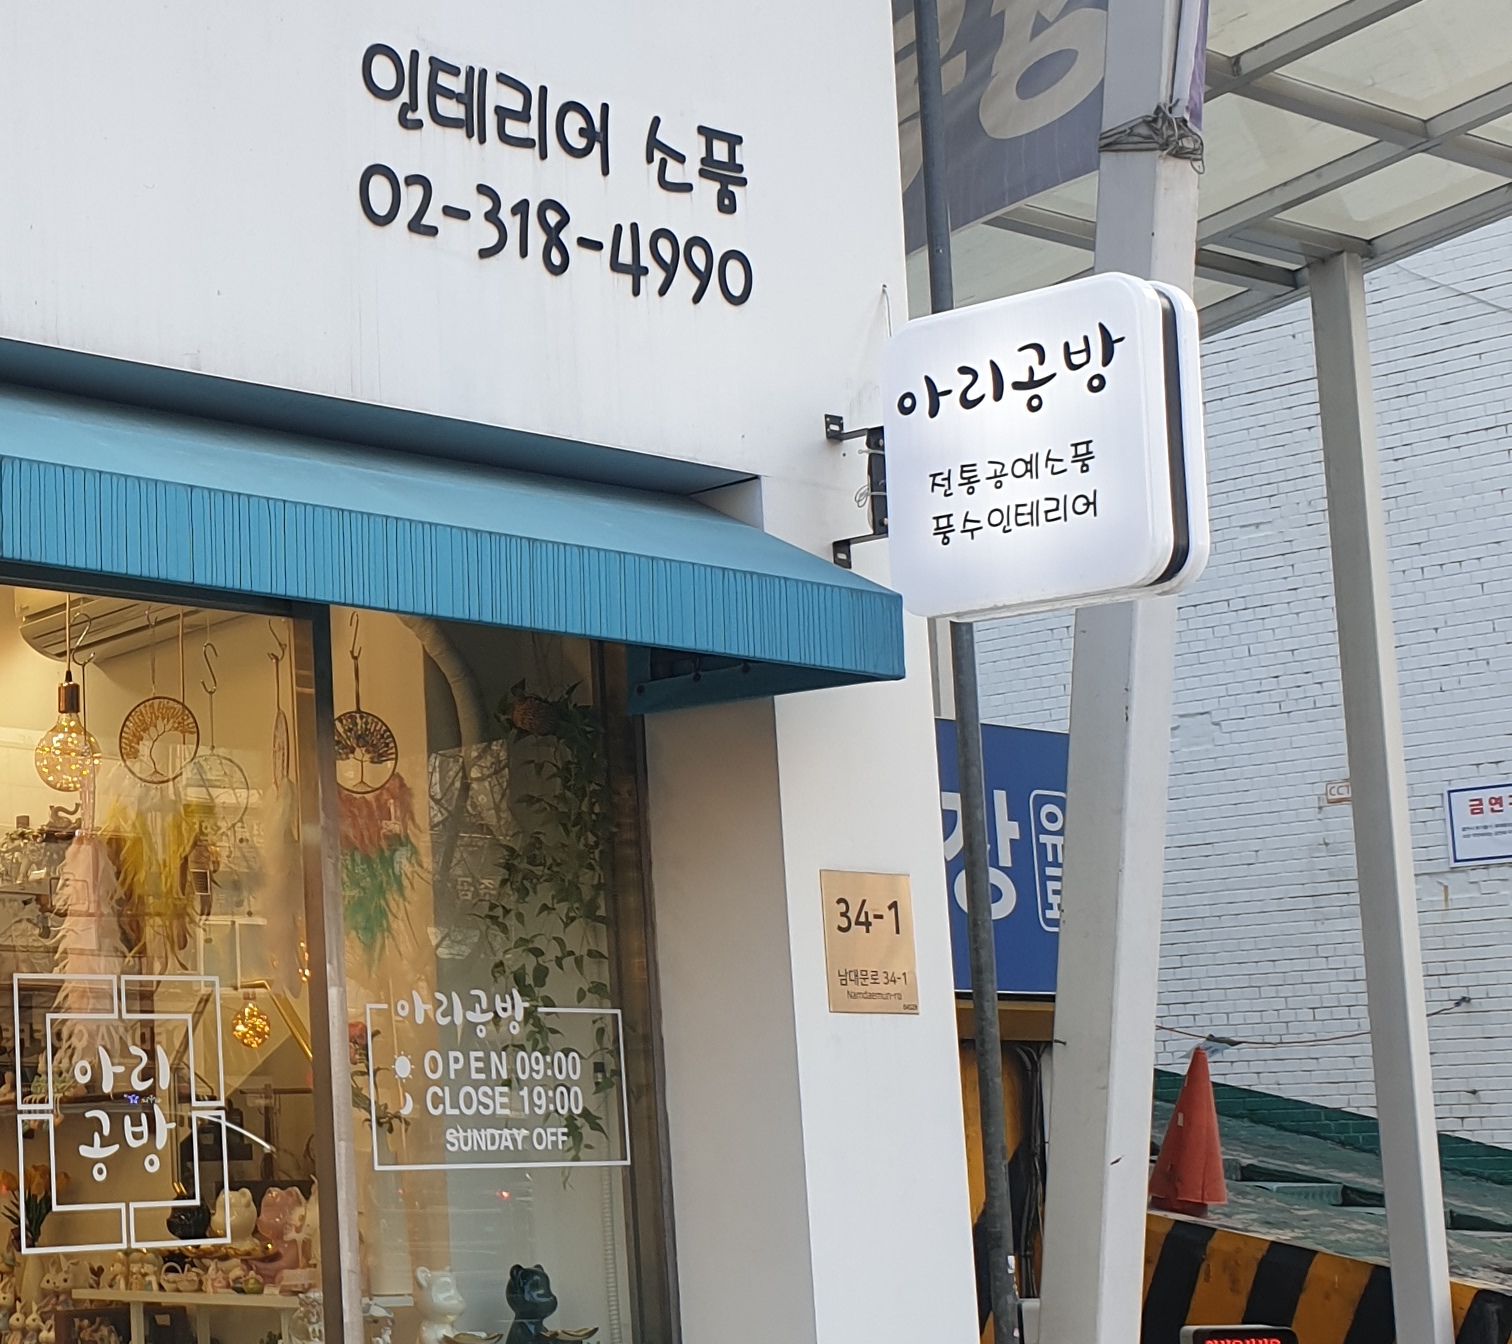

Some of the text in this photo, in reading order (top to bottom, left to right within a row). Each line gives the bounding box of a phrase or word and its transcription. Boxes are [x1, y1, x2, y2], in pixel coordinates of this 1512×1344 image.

[362, 43, 748, 214] 인테리어 소품
[359, 164, 753, 306] 02-318-4990
[897, 322, 1125, 418] 아리공방
[932, 489, 1099, 545] 풍수인테리어
[1469, 795, 1512, 815] 금연
[836, 898, 900, 934] 34-1
[838, 968, 907, 986] 남대문로 34-1
[397, 988, 530, 1038] 아리공방
[74, 1044, 170, 1093] 아리
[424, 1050, 581, 1080] OPEN 09:00
[426, 1085, 583, 1116] CLOSE 19:00
[78, 1103, 176, 1181] 공방
[445, 1127, 569, 1153] SUNDAY OFF
